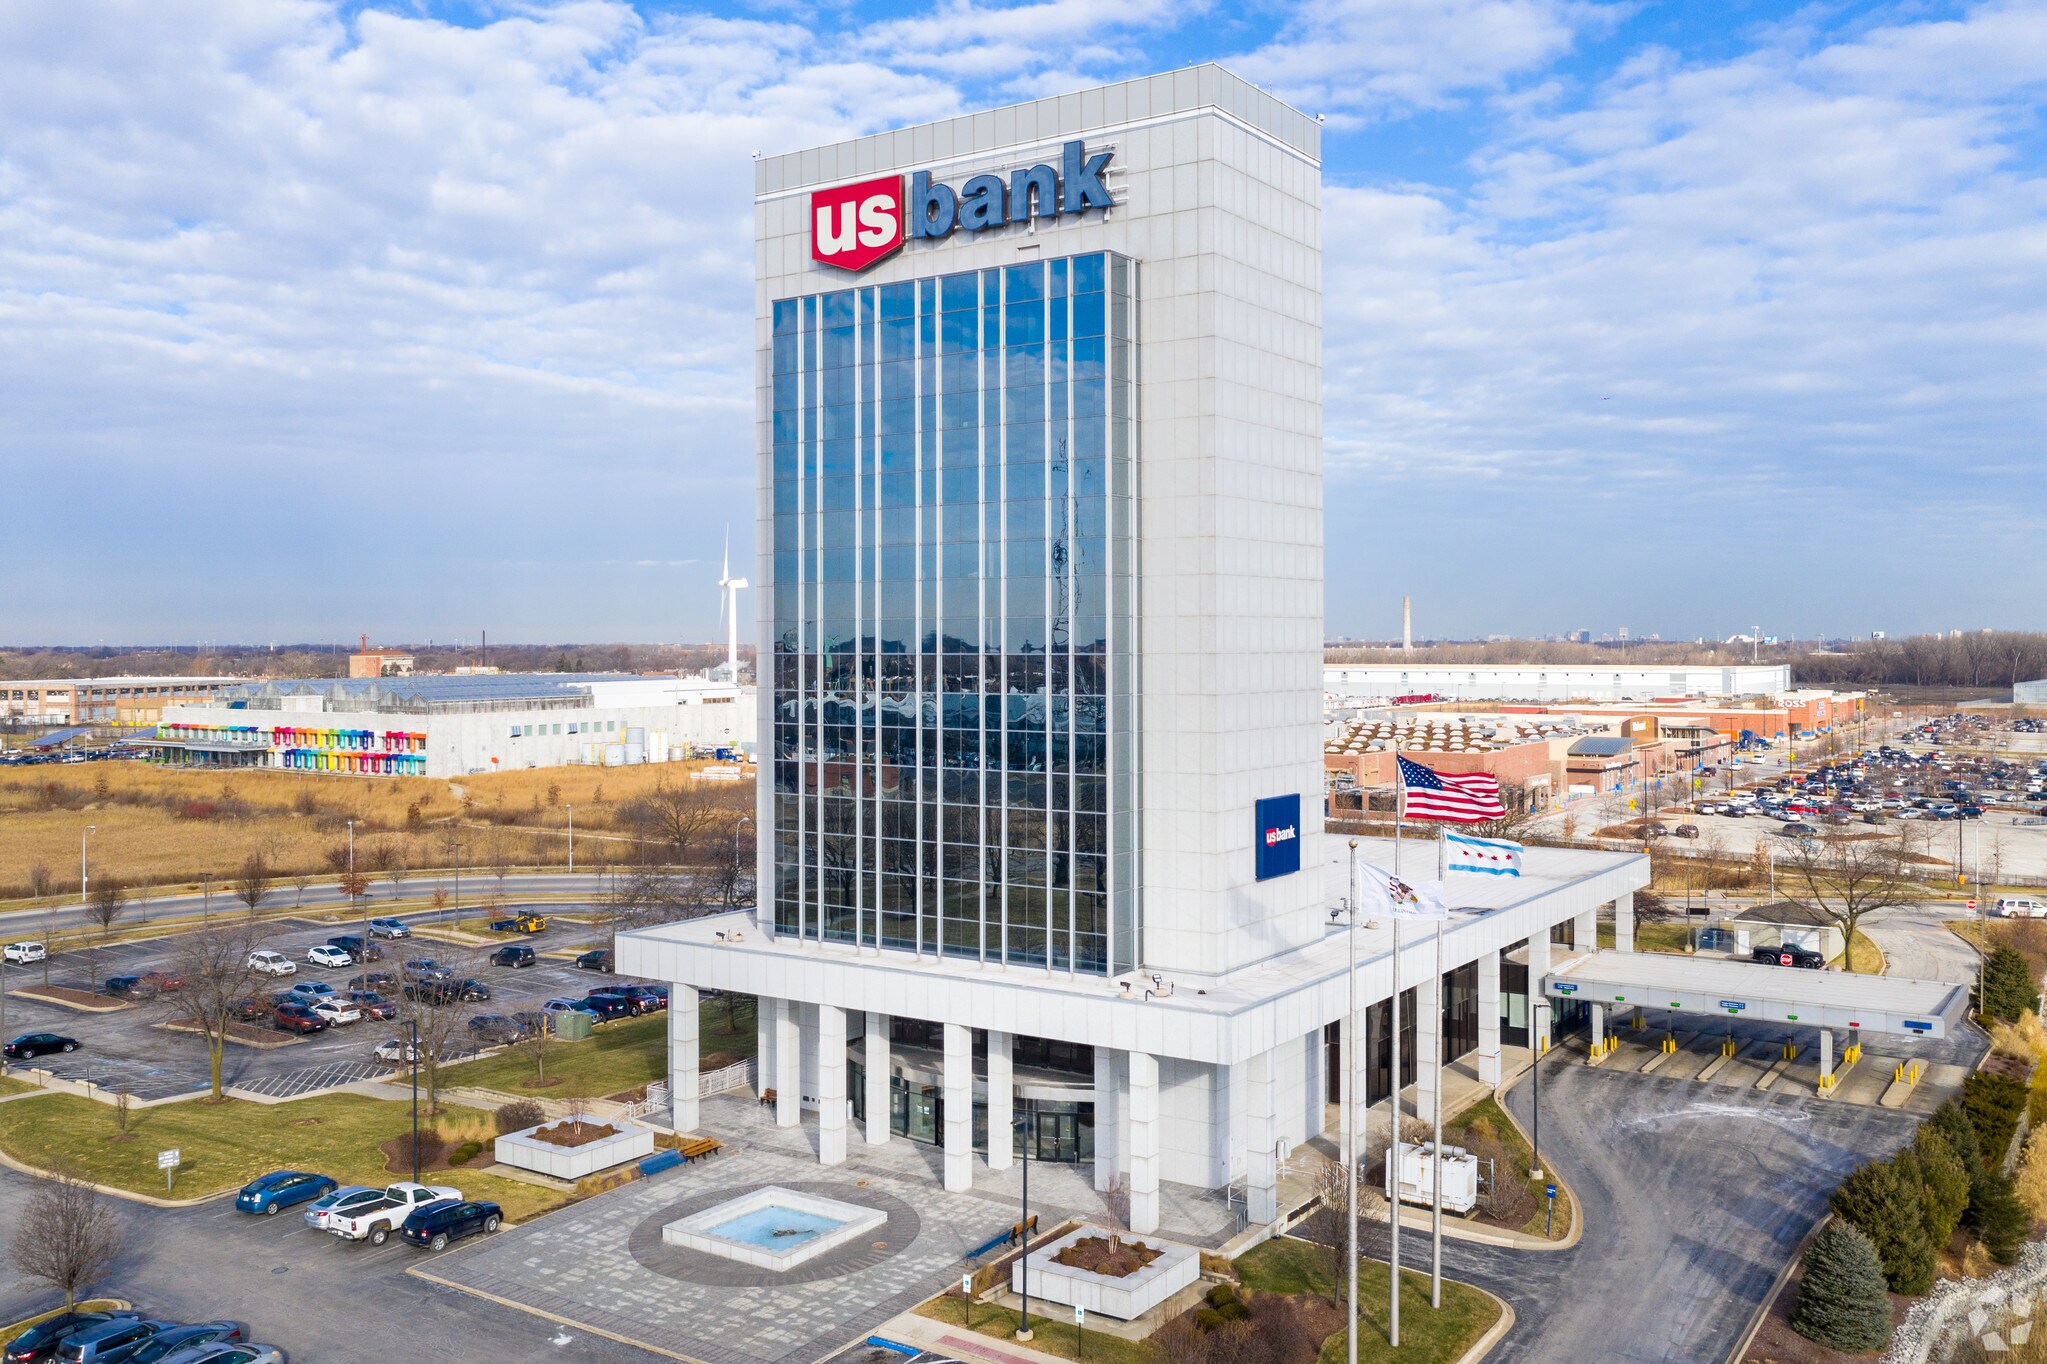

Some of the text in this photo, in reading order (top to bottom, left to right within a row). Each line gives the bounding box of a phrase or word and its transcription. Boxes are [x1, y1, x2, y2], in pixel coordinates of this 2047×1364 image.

[816, 140, 1116, 256] us bank
[1777, 700, 1806, 708] ROSS
[1276, 824, 1296, 842] bank
